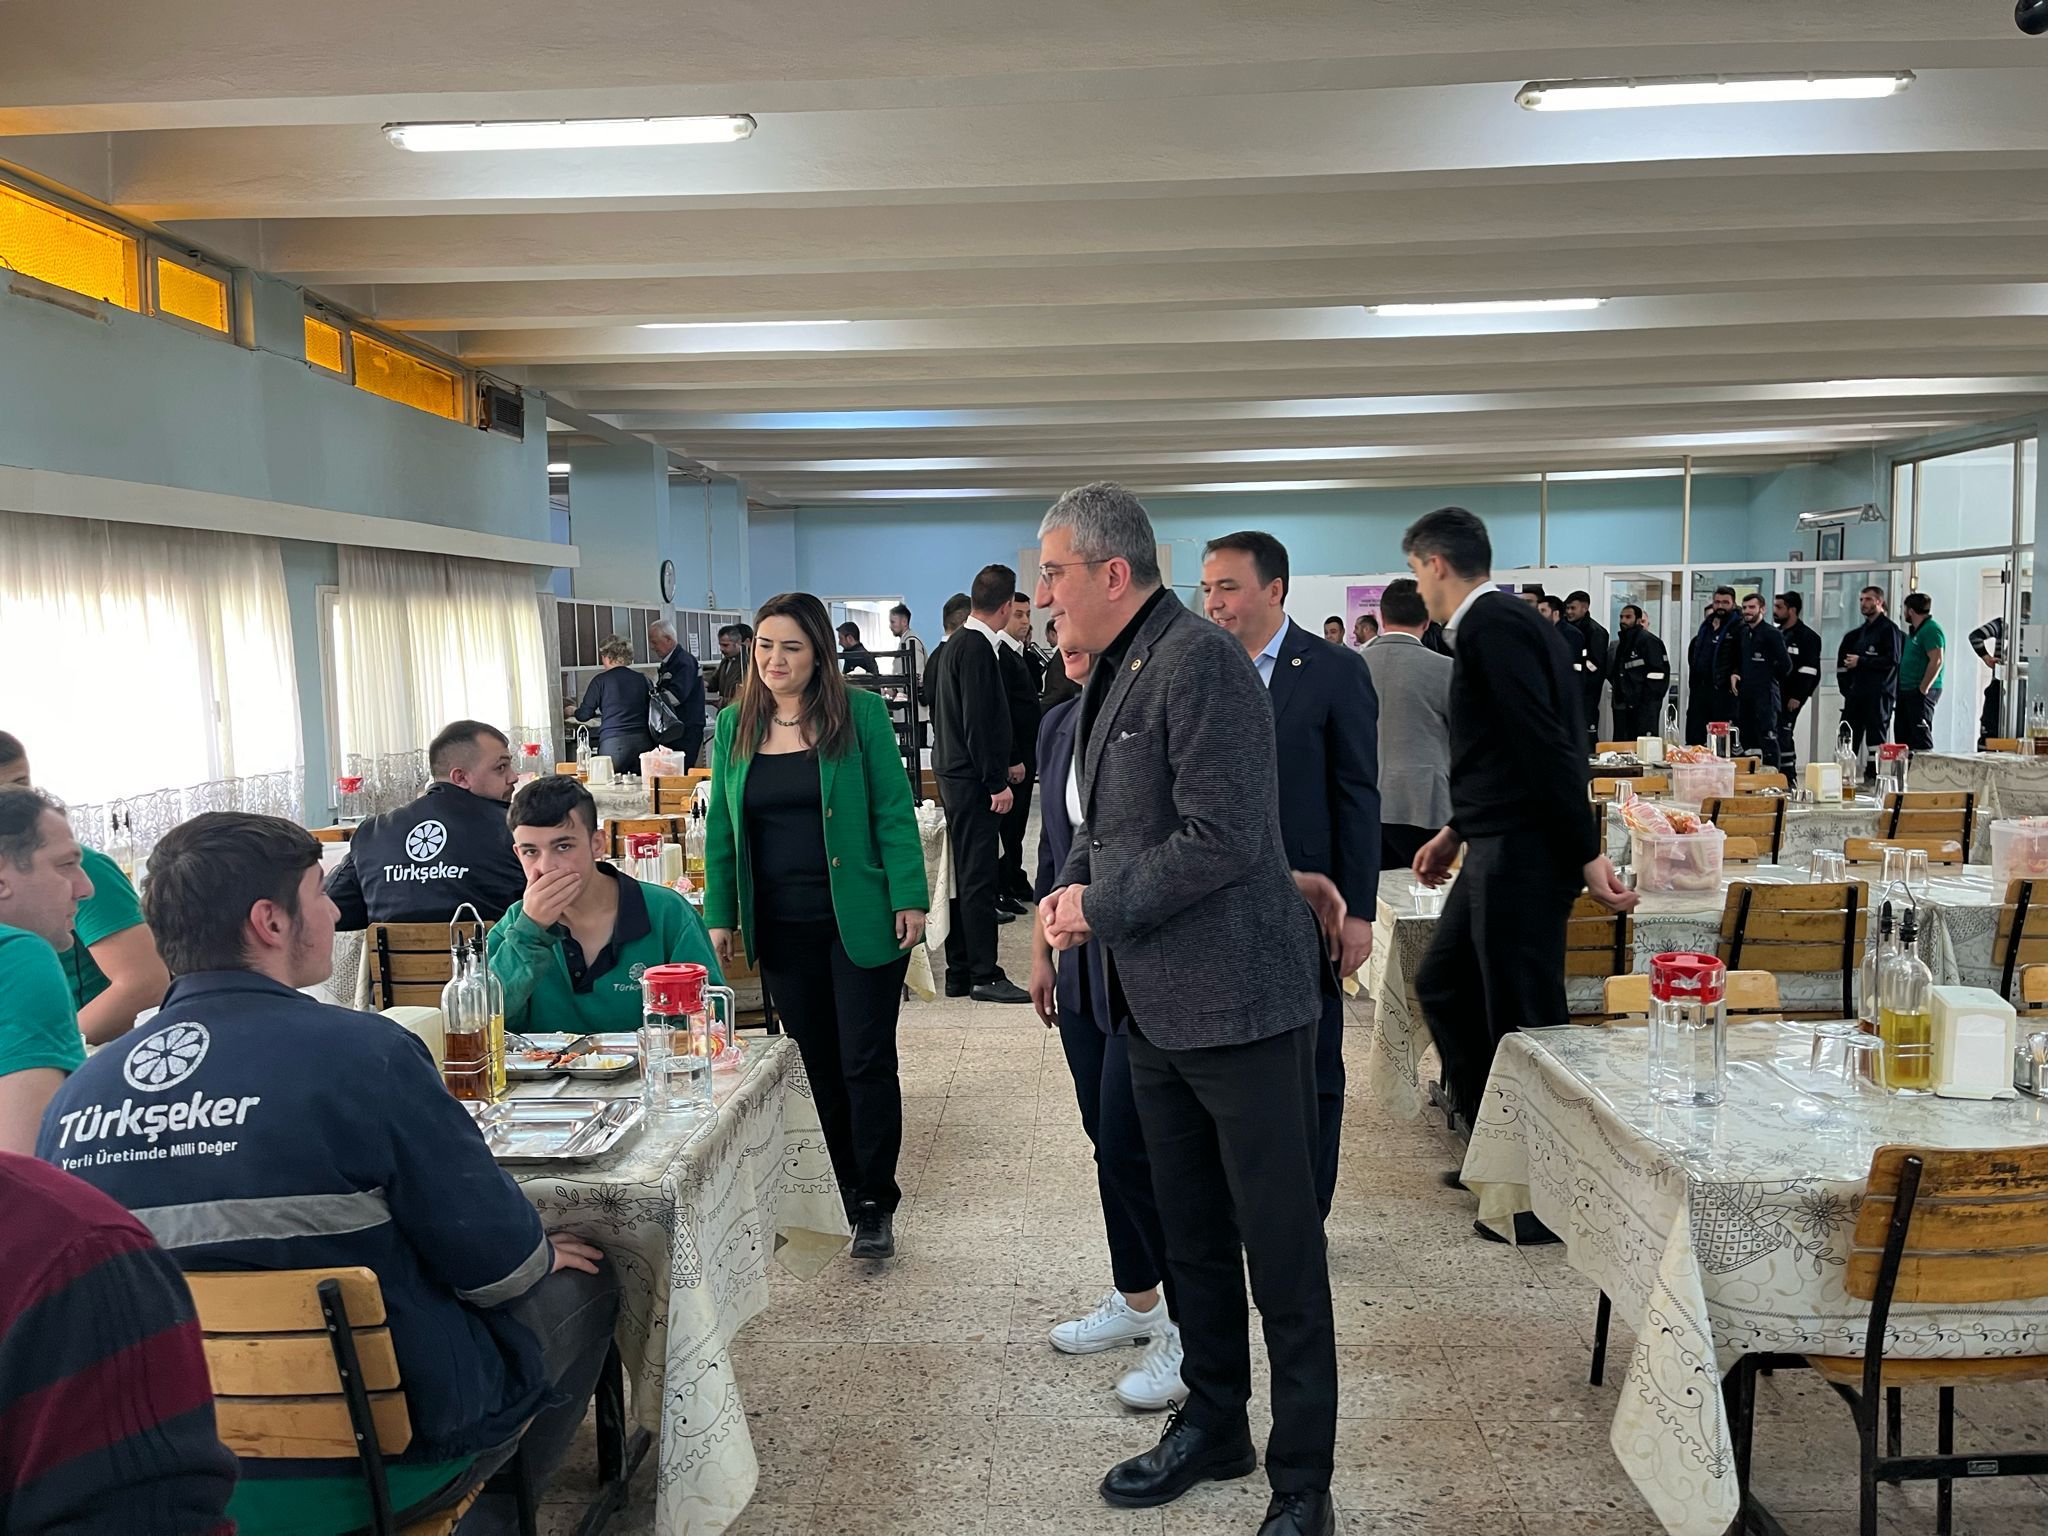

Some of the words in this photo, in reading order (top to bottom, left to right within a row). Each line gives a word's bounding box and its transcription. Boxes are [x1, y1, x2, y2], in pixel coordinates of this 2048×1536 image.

[383, 861, 469, 884] Türkşeker
[59, 1091, 261, 1149] Türkşeker
[62, 1154, 93, 1171] Yerli
[96, 1147, 168, 1165] Üretimde
[170, 1142, 196, 1158] Milli
[198, 1141, 238, 1156] Değer
